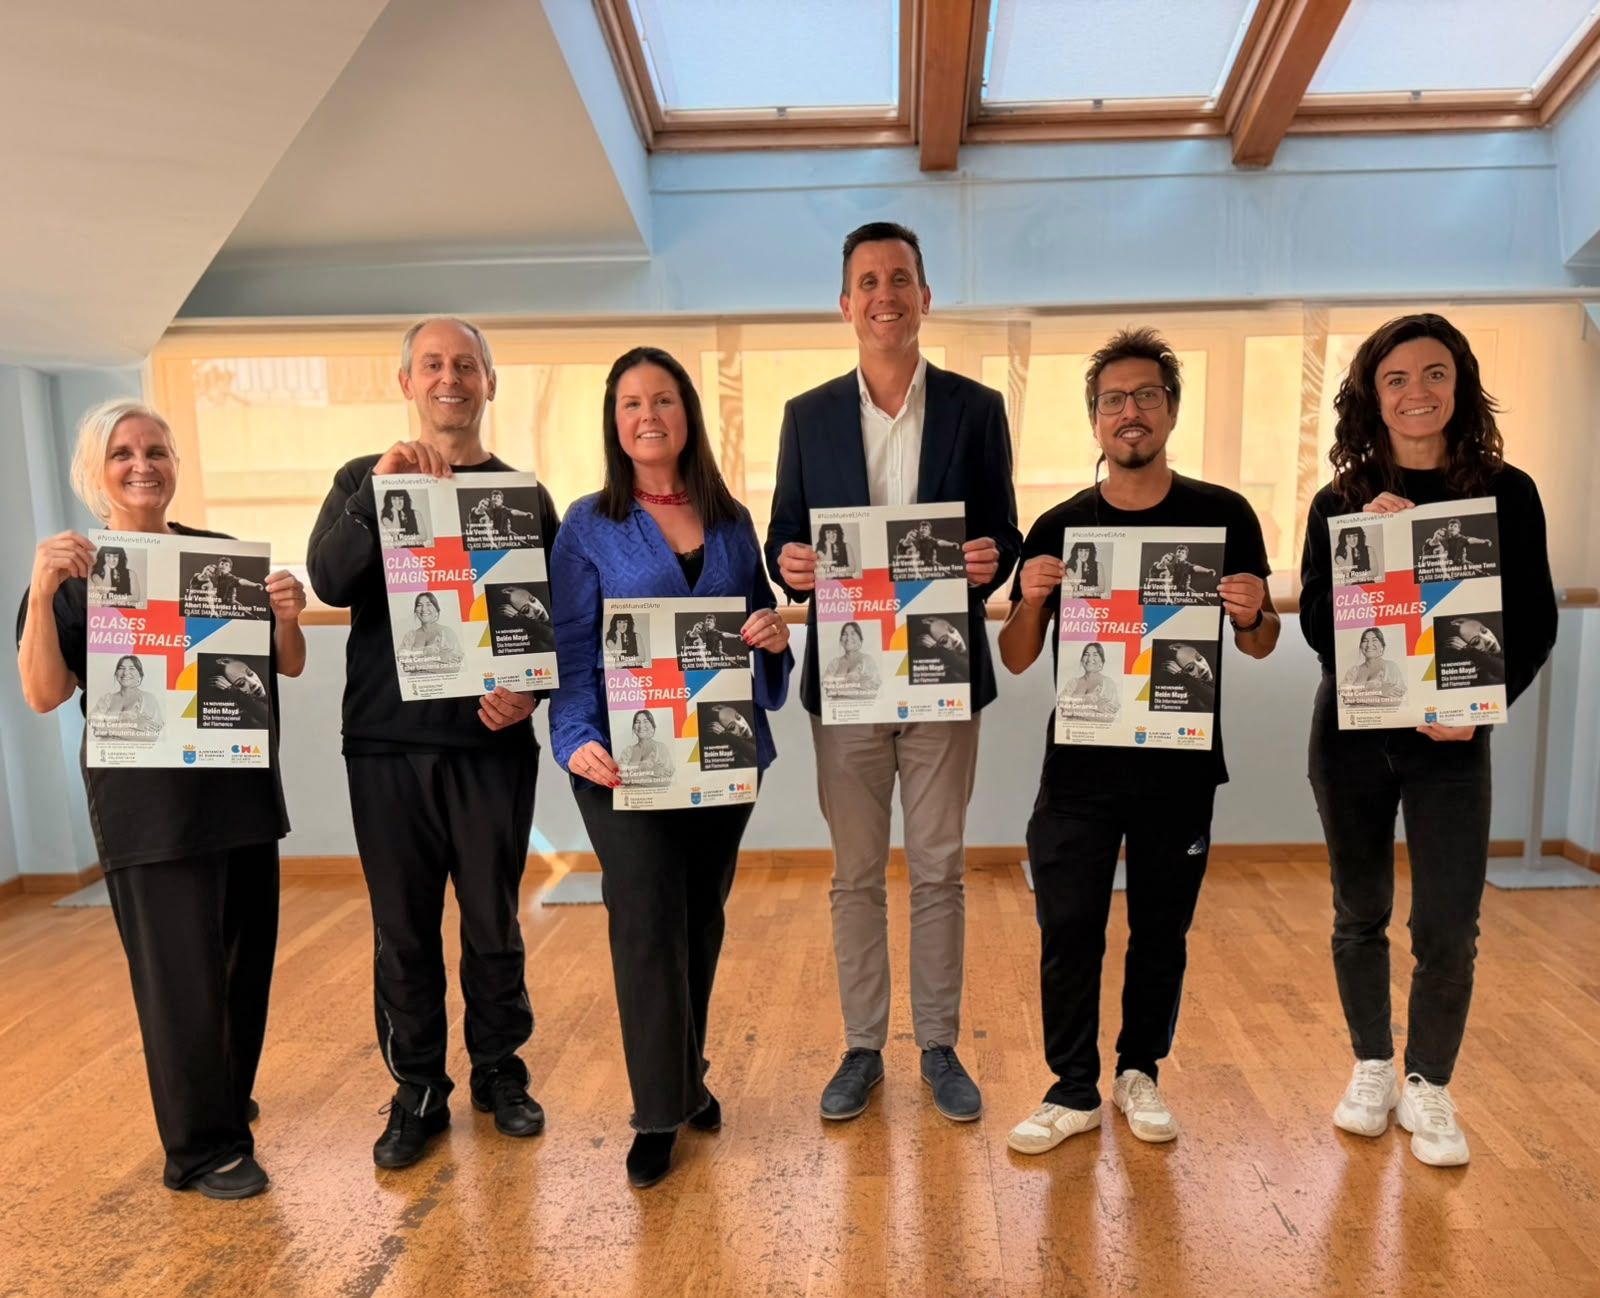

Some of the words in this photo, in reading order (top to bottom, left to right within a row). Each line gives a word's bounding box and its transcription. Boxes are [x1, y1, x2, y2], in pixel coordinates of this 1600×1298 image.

[96, 534, 161, 545] #NosMueveElArte
[384, 555, 436, 570] CLASES
[386, 568, 478, 584] MAGISTRALES
[1451, 569, 1475, 578] ESPAÑOLA
[817, 586, 862, 600] CLASES
[1335, 590, 1384, 607] CLASES
[219, 609, 244, 617] ESPAÑOLA
[817, 598, 901, 614] MAGISTRALES
[1062, 606, 1108, 619] CLASES
[1335, 601, 1427, 621] MAGISTRALES
[89, 615, 145, 631] CLASES
[1060, 620, 1148, 634] MAGISTRALES
[88, 630, 192, 648] MAGISTRALES
[495, 634, 511, 642] Belén
[1440, 667, 1457, 675] Belén
[607, 675, 652, 689] CLASES
[608, 687, 690, 702] MAGISTRALES
